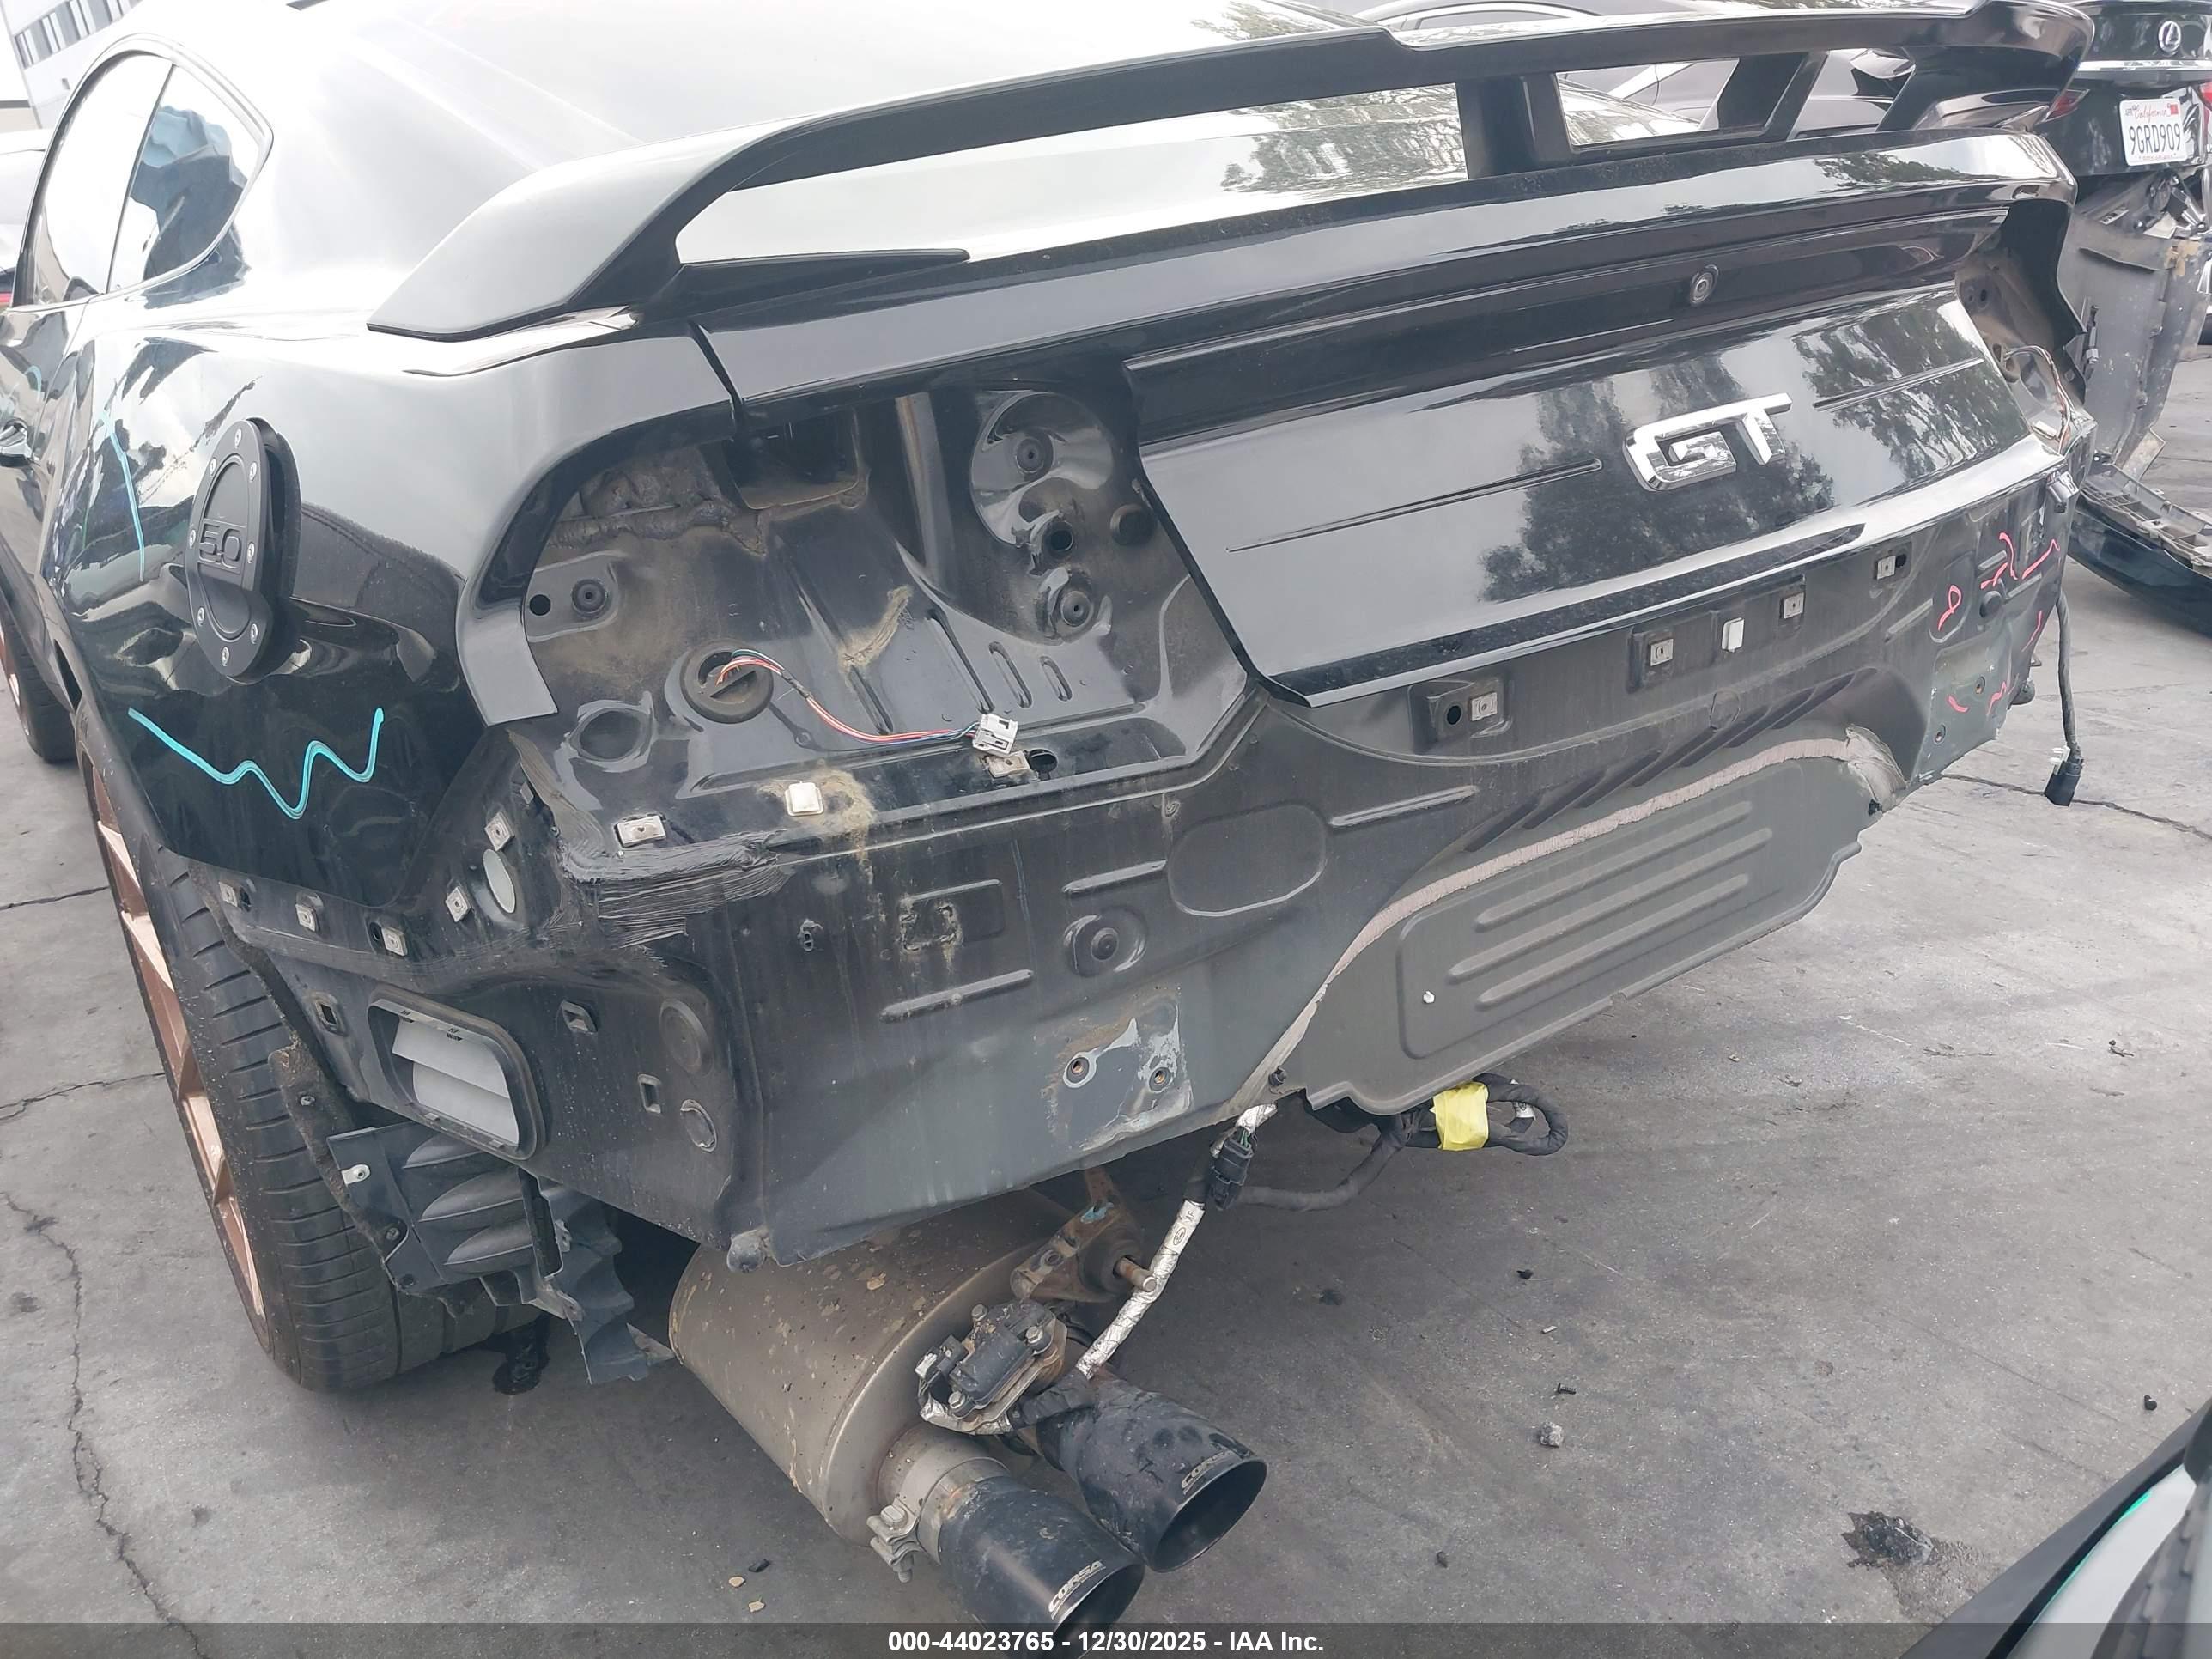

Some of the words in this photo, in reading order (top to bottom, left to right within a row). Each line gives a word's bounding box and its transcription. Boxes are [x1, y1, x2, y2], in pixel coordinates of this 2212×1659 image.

[2129, 123, 2180, 155] 9GRD909
[1622, 392, 1793, 492] GT
[1048, 1560, 1105, 1613] CORSA
